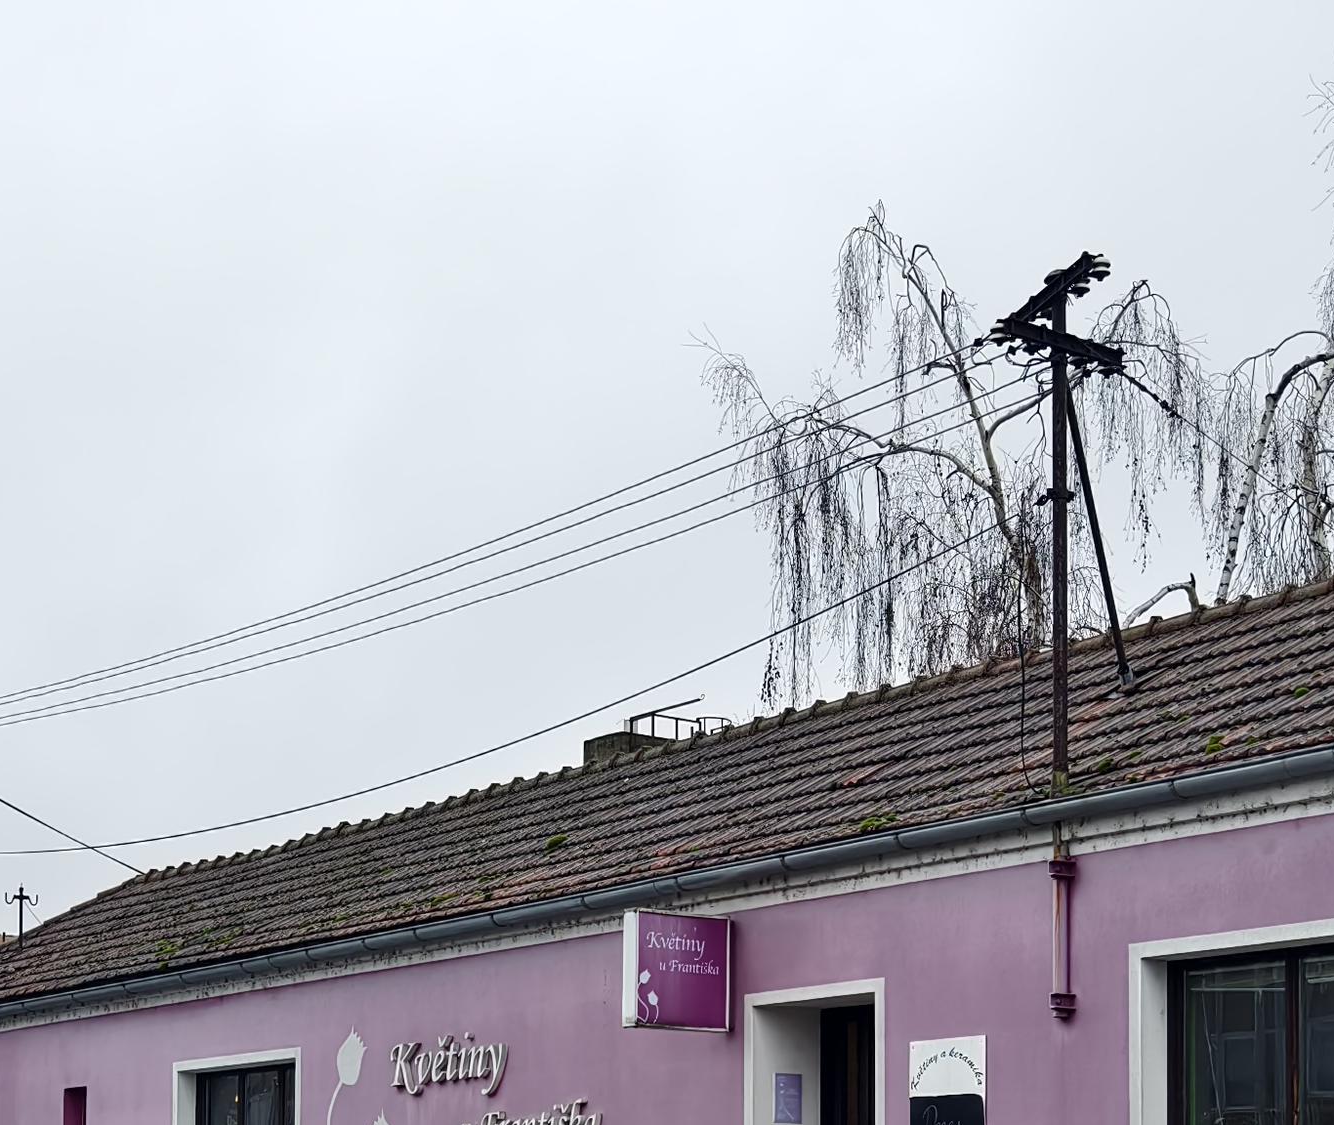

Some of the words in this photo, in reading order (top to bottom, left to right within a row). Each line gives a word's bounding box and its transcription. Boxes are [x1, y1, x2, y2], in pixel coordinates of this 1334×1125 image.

[646, 927, 706, 961] Květiny
[659, 961, 667, 972] u
[668, 959, 720, 976] Františka
[390, 1032, 507, 1096] Květiny
[948, 1046, 984, 1086] keramika
